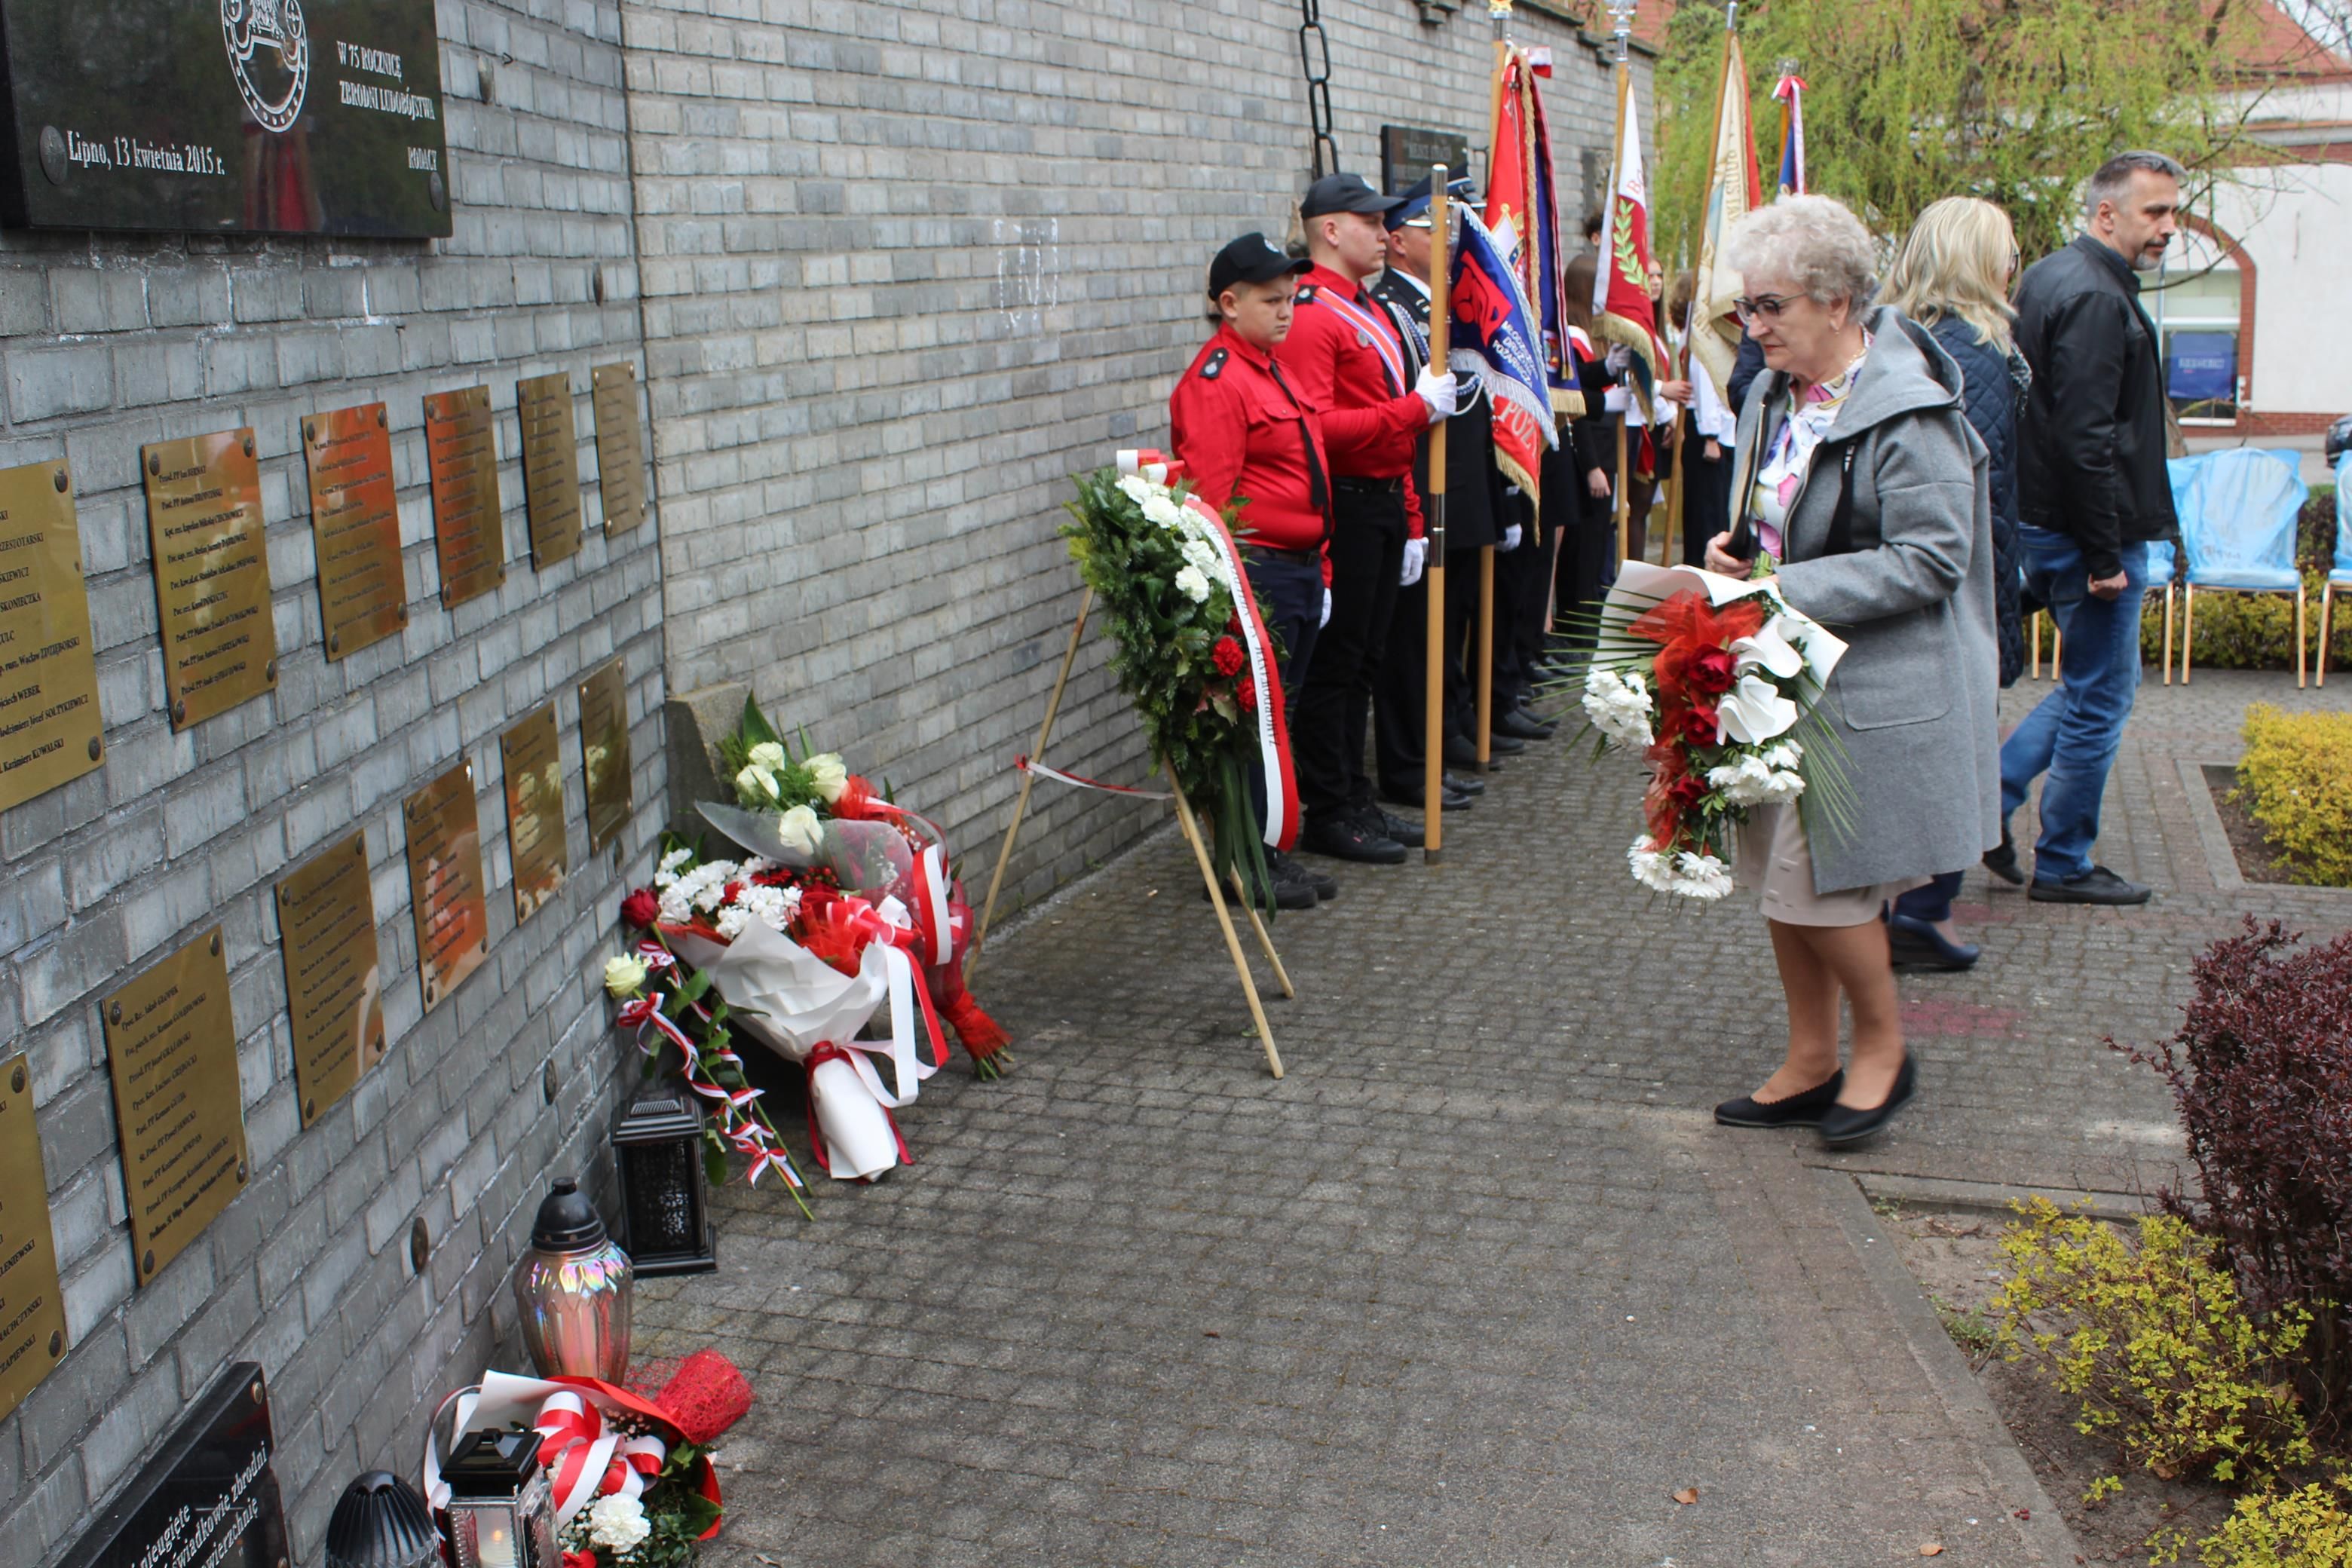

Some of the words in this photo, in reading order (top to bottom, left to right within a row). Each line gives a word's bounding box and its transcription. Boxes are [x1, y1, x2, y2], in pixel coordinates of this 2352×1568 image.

[336, 41, 347, 66] W
[348, 44, 360, 68] 75
[360, 47, 403, 84] ROCZNICĘ
[339, 81, 379, 110] ZBRODNI
[380, 87, 436, 121] LUDOBÓJSTWA
[67, 130, 112, 171] Lipno,
[114, 136, 130, 166] 13
[133, 138, 184, 172] kwietnia
[185, 145, 214, 174] 2015
[216, 155, 225, 175] r.
[407, 146, 437, 170] RODACY
[231, 1440, 267, 1503] zbrodni
